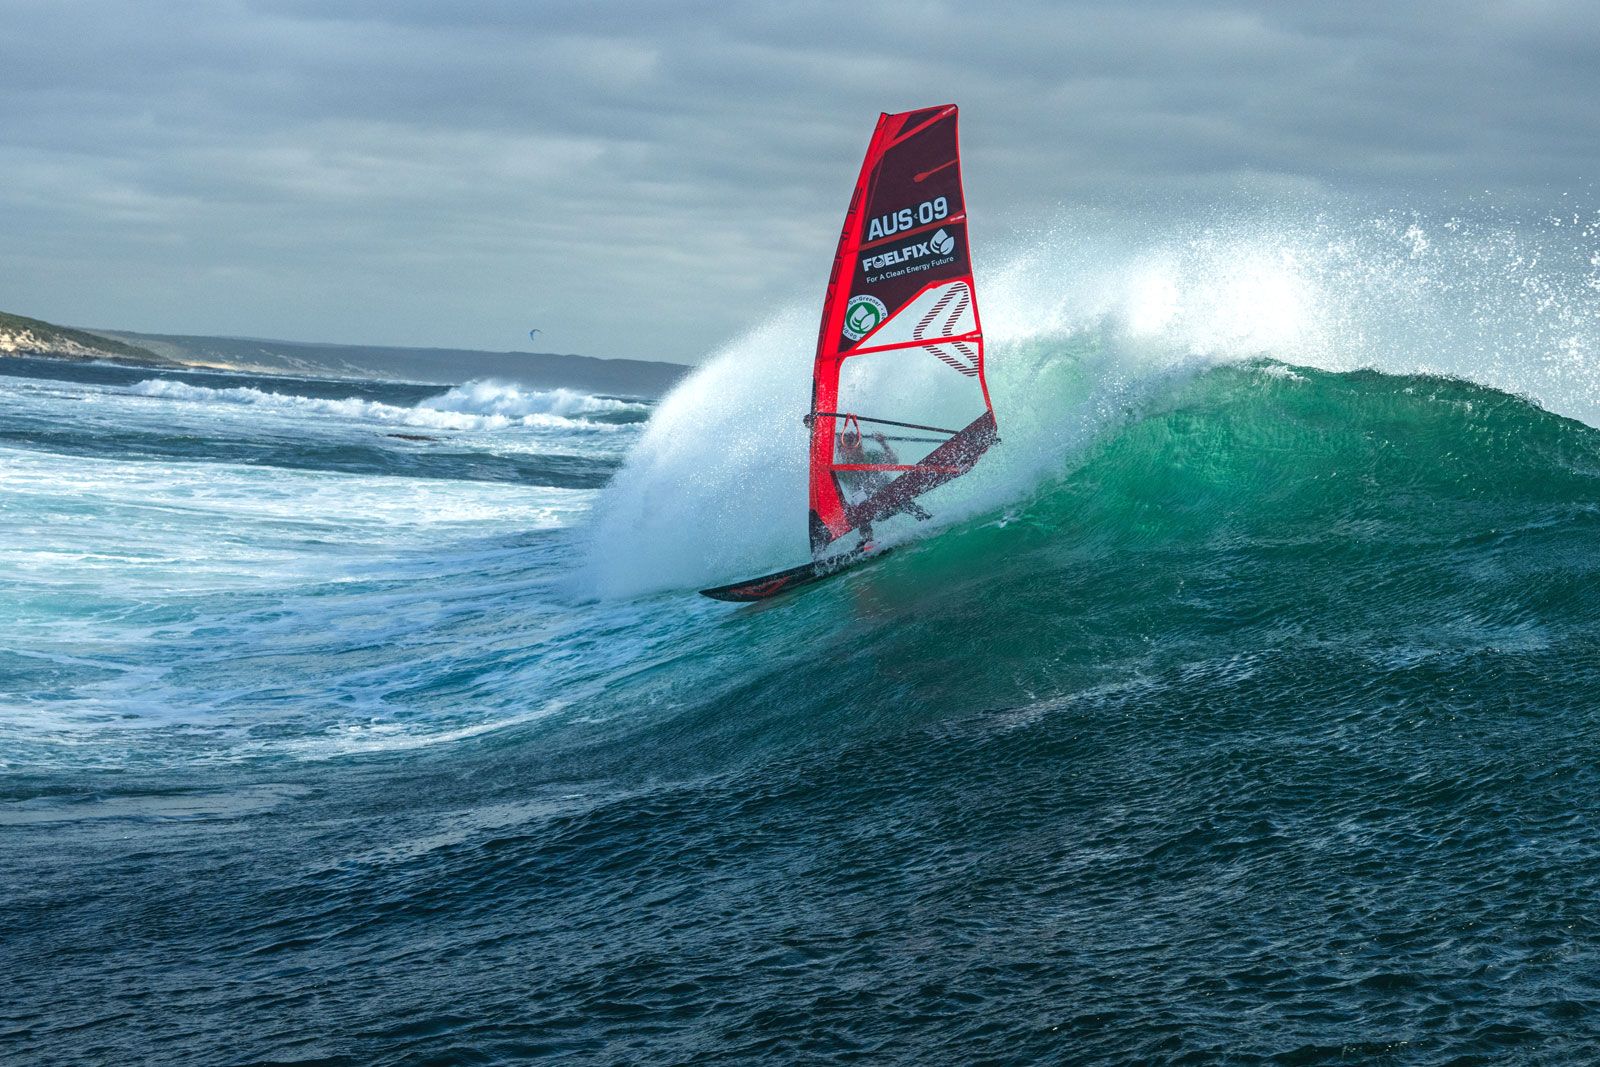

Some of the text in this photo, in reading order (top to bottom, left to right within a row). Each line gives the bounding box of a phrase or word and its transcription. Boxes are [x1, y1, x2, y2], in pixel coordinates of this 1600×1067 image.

[868, 196, 948, 241] AUS 09
[866, 255, 954, 284] For A Clean Energy Future
